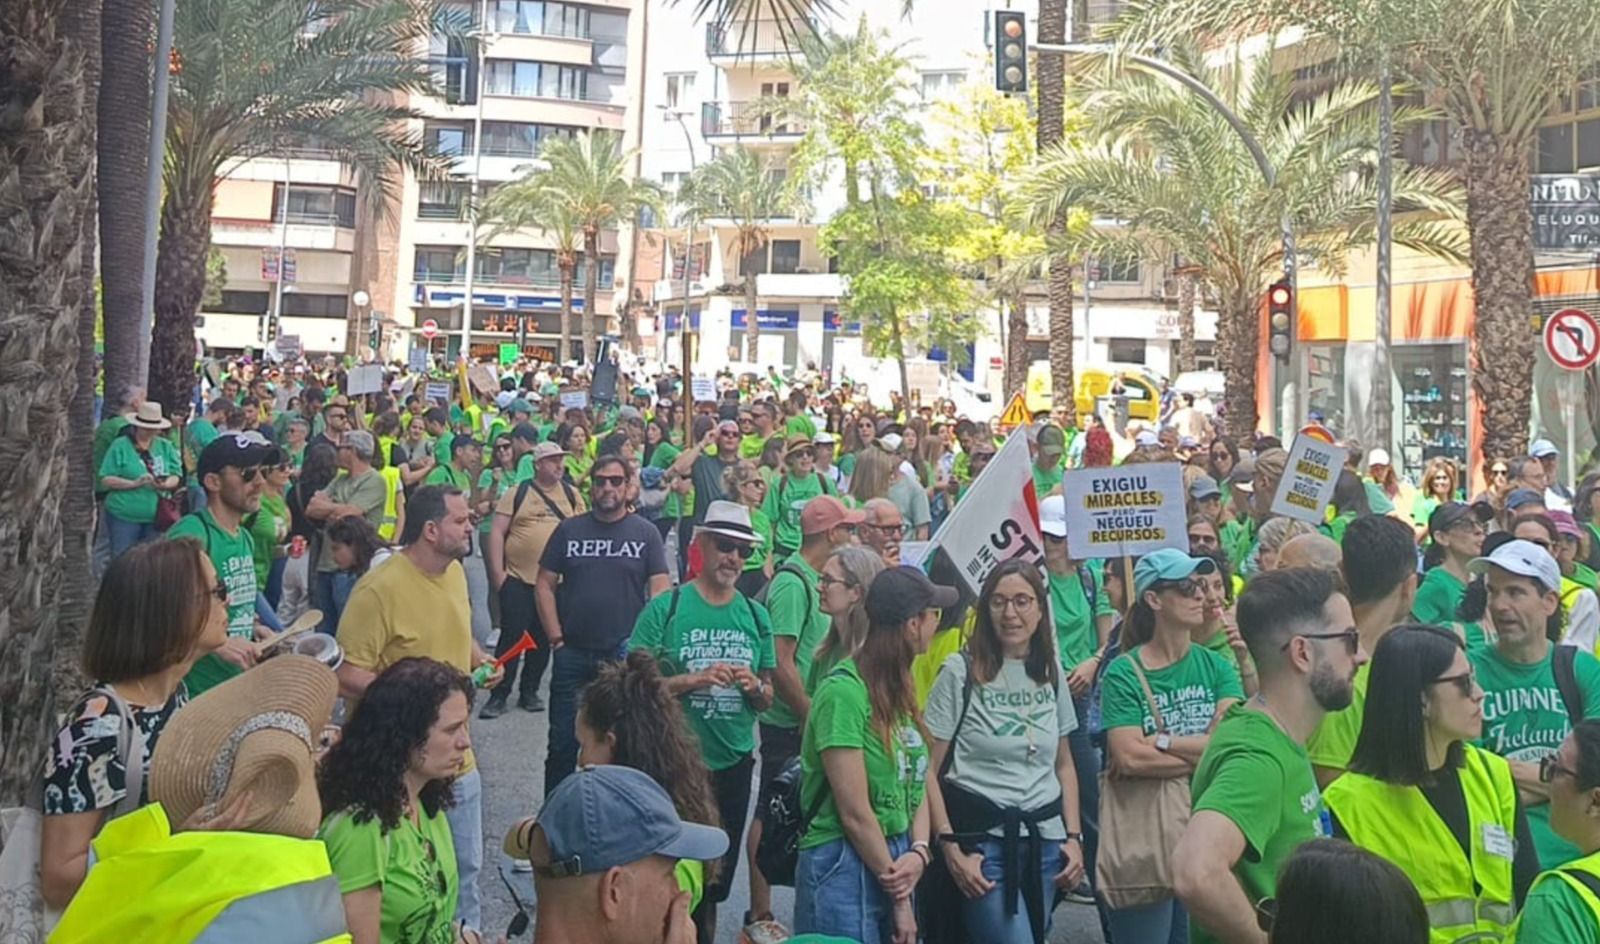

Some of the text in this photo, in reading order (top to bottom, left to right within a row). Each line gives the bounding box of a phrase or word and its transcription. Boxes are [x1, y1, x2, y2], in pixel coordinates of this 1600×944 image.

[1092, 476, 1147, 493] EXIGIU
[1086, 490, 1162, 509] MIRACLES,
[1097, 515, 1153, 530] NEGUEU
[1091, 527, 1165, 543] RECURSOS.
[566, 540, 645, 558] REPLAY
[690, 628, 745, 642] EN LUCHA
[680, 646, 722, 661] FUTURO
[980, 686, 1056, 709] Reebok
[1481, 687, 1569, 720] GUINNE
[1489, 720, 1569, 754] Ireland
